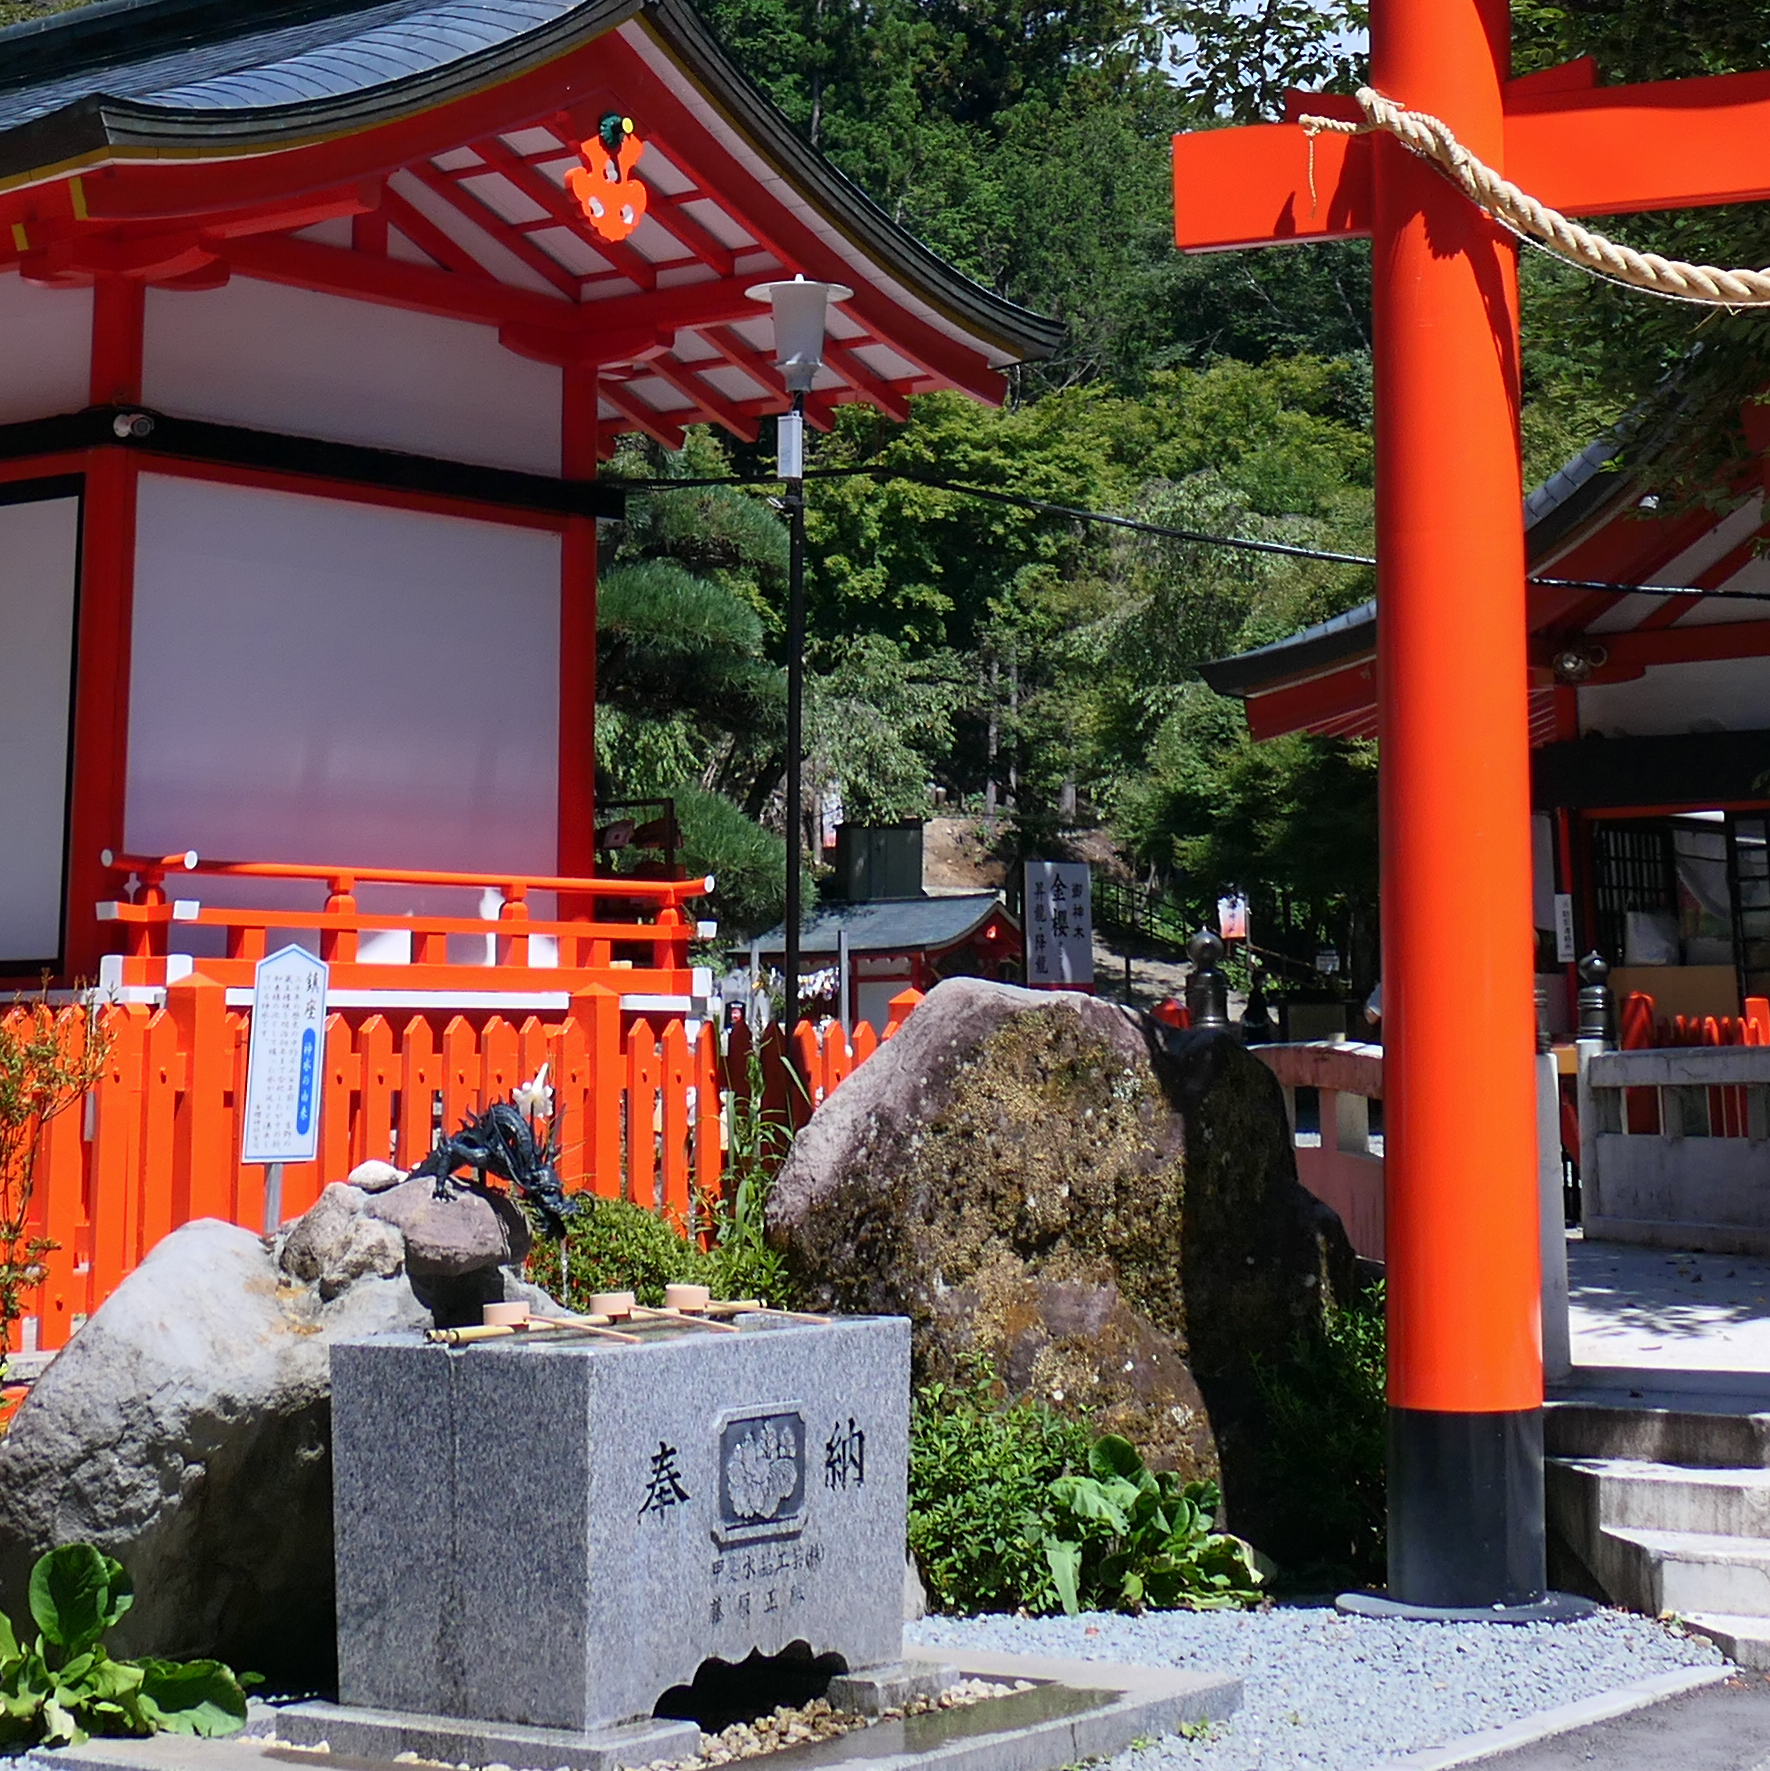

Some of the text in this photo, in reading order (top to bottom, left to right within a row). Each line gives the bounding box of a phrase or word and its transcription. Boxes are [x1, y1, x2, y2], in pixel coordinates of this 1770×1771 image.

[1034, 882, 1048, 974] 昇龍・降龍
[1050, 873, 1070, 938] 金櫻
[1071, 883, 1086, 940] 御神木
[304, 972, 320, 1020] 鎮座
[300, 1041, 313, 1121] 神水の由来
